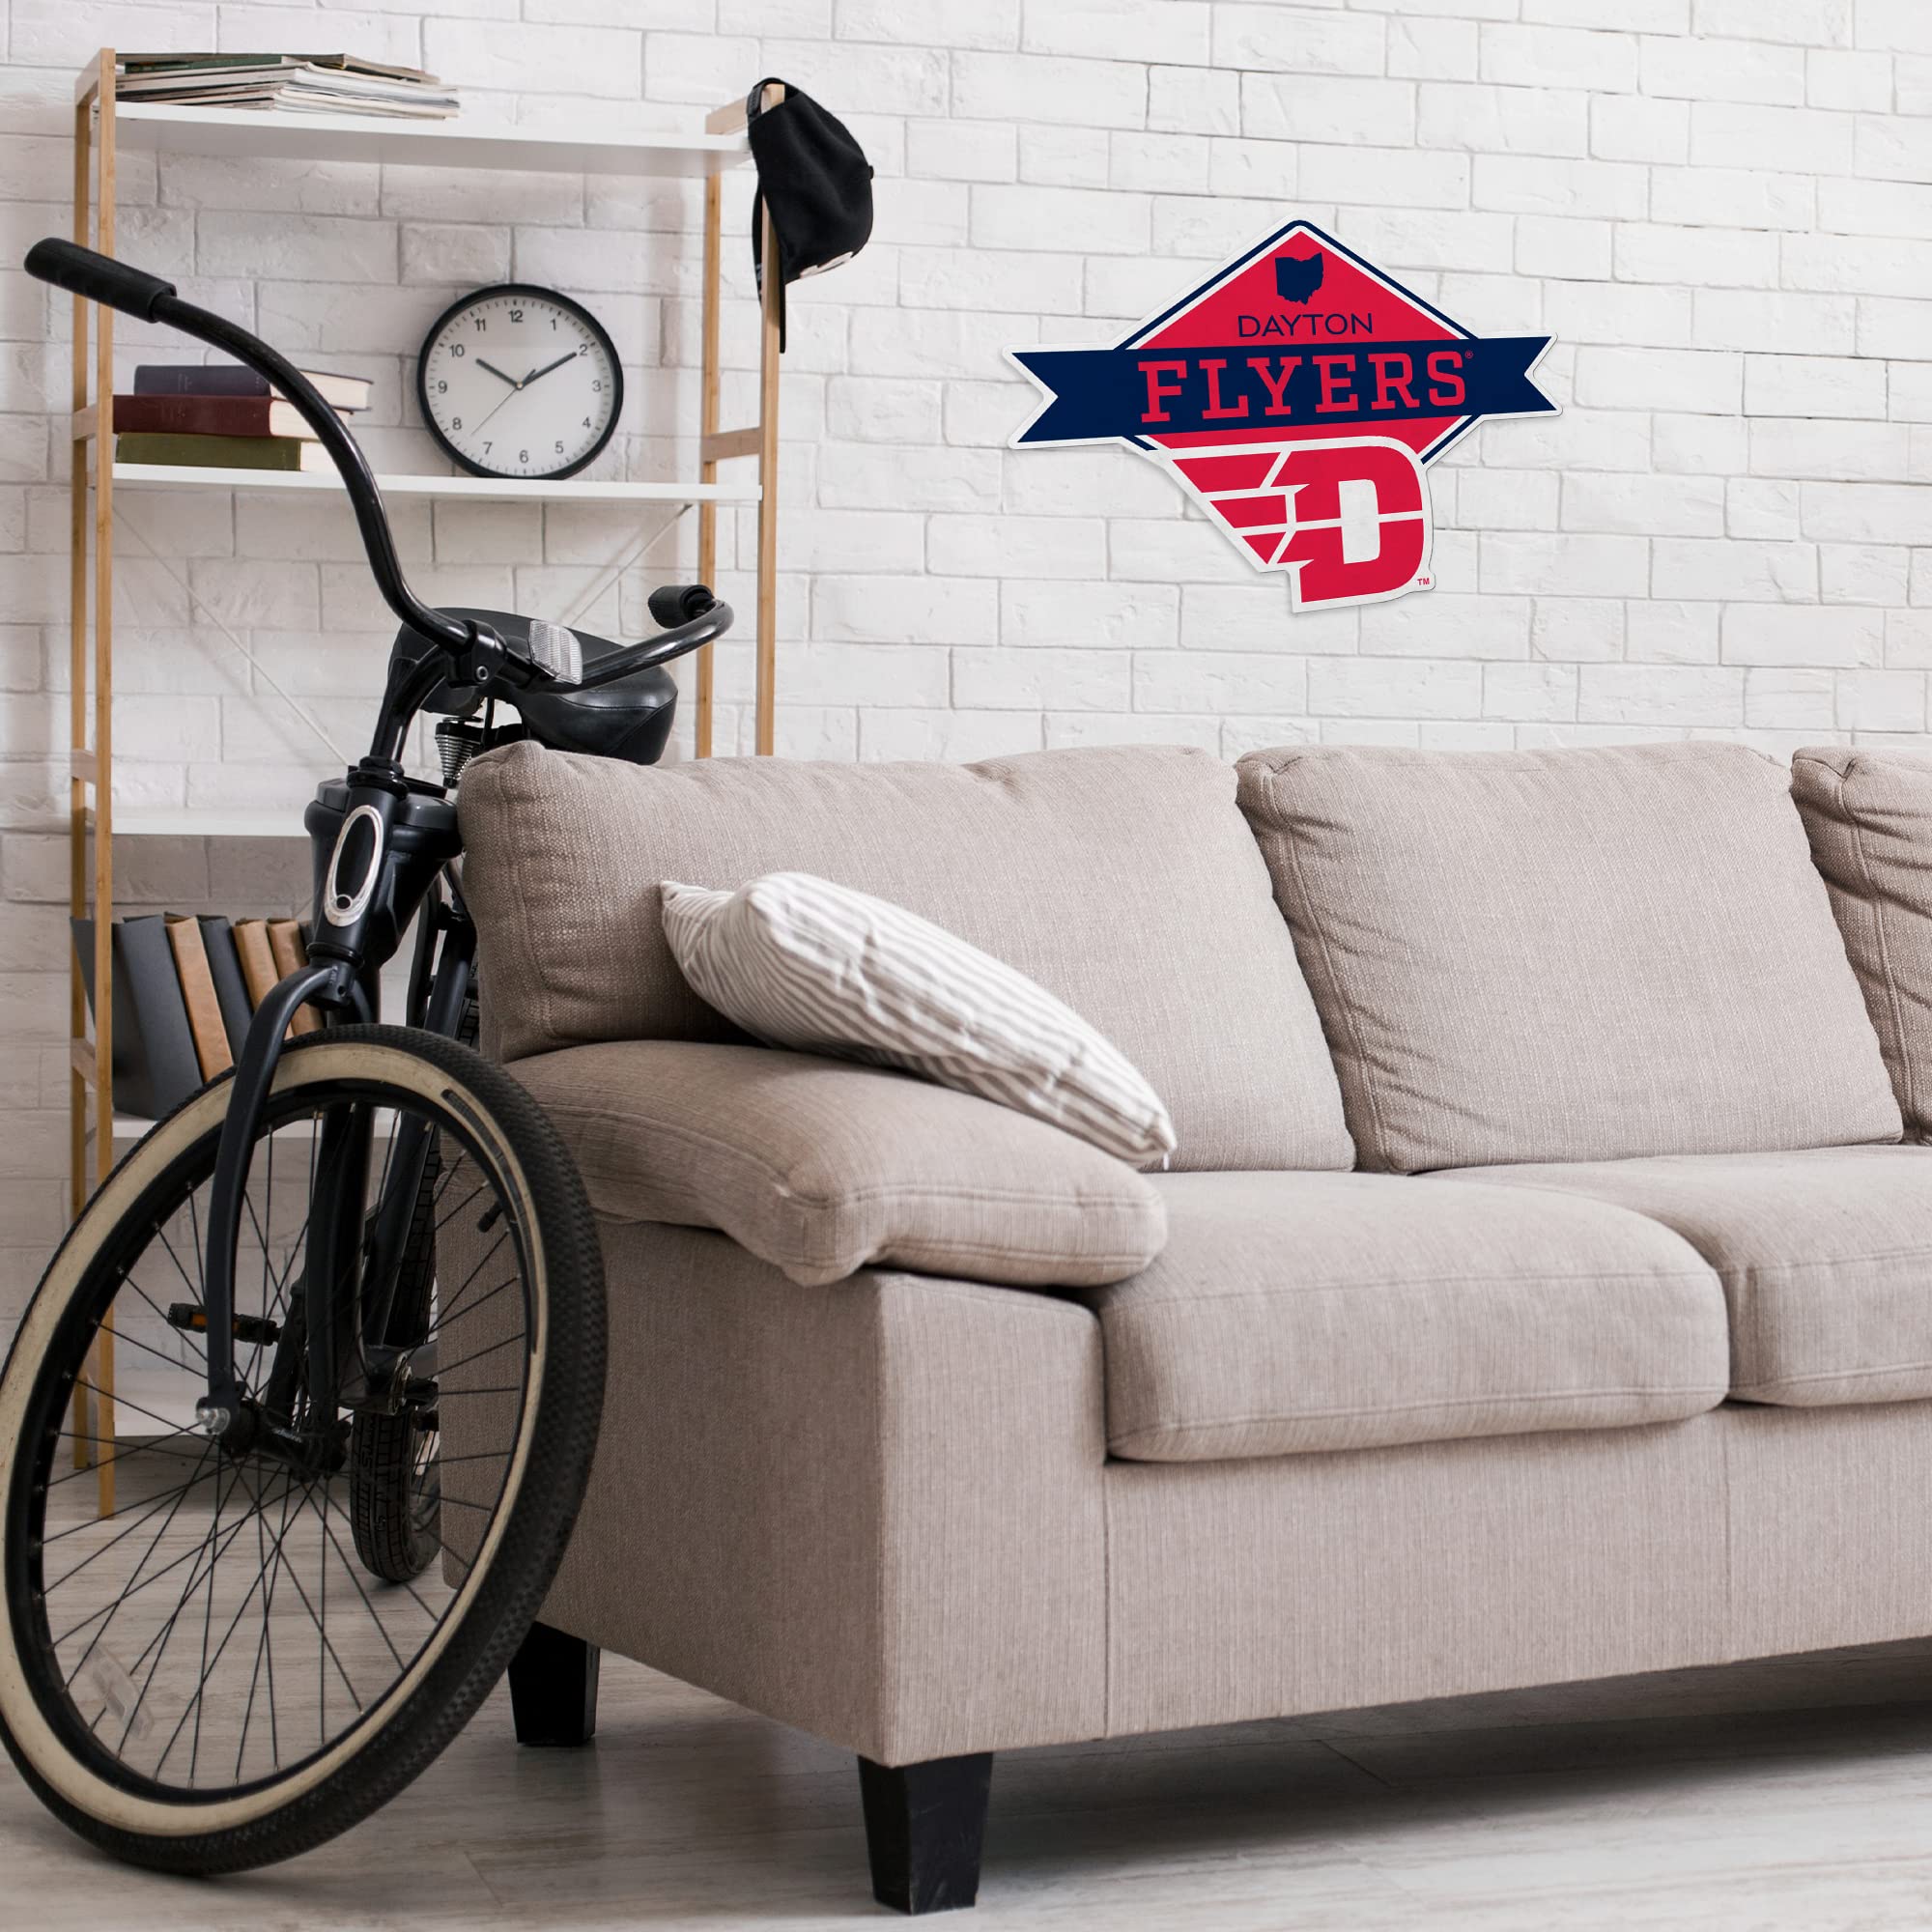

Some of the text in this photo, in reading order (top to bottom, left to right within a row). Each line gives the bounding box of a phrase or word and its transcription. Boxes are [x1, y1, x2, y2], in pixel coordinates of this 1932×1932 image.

[508, 309, 524, 324] 12
[474, 318, 487, 331] 11
[550, 319, 556, 330] 1
[1237, 312, 1373, 338] DAYTON
[449, 343, 465, 357] 10
[579, 344, 588, 356] 2
[438, 381, 447, 394] 9
[591, 380, 602, 392] 3
[452, 417, 462, 431] 8
[582, 416, 591, 428] 4
[483, 441, 493, 455] 7
[554, 440, 564, 454] 5
[519, 449, 529, 464] 6
